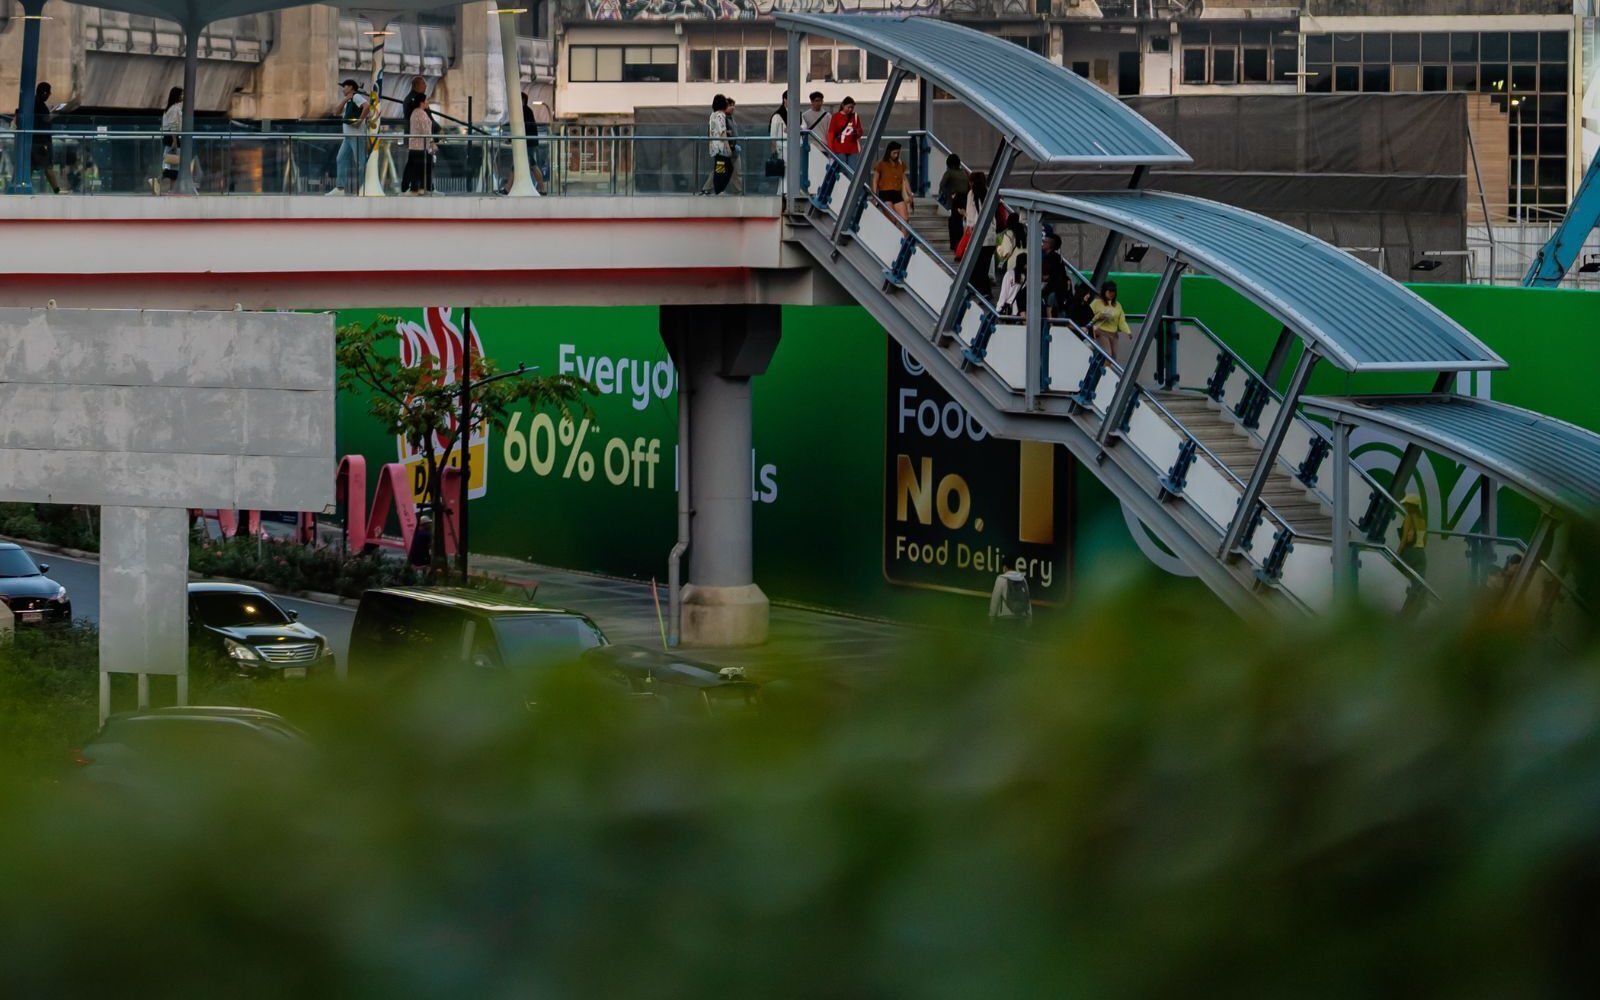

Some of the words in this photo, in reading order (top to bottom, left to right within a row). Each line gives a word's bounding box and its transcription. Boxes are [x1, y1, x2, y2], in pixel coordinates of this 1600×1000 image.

[559, 343, 679, 411] Everyd
[604, 437, 661, 489] Off
[896, 454, 984, 532] No.
[896, 535, 949, 565] Food
[957, 543, 1053, 588] Deliery
